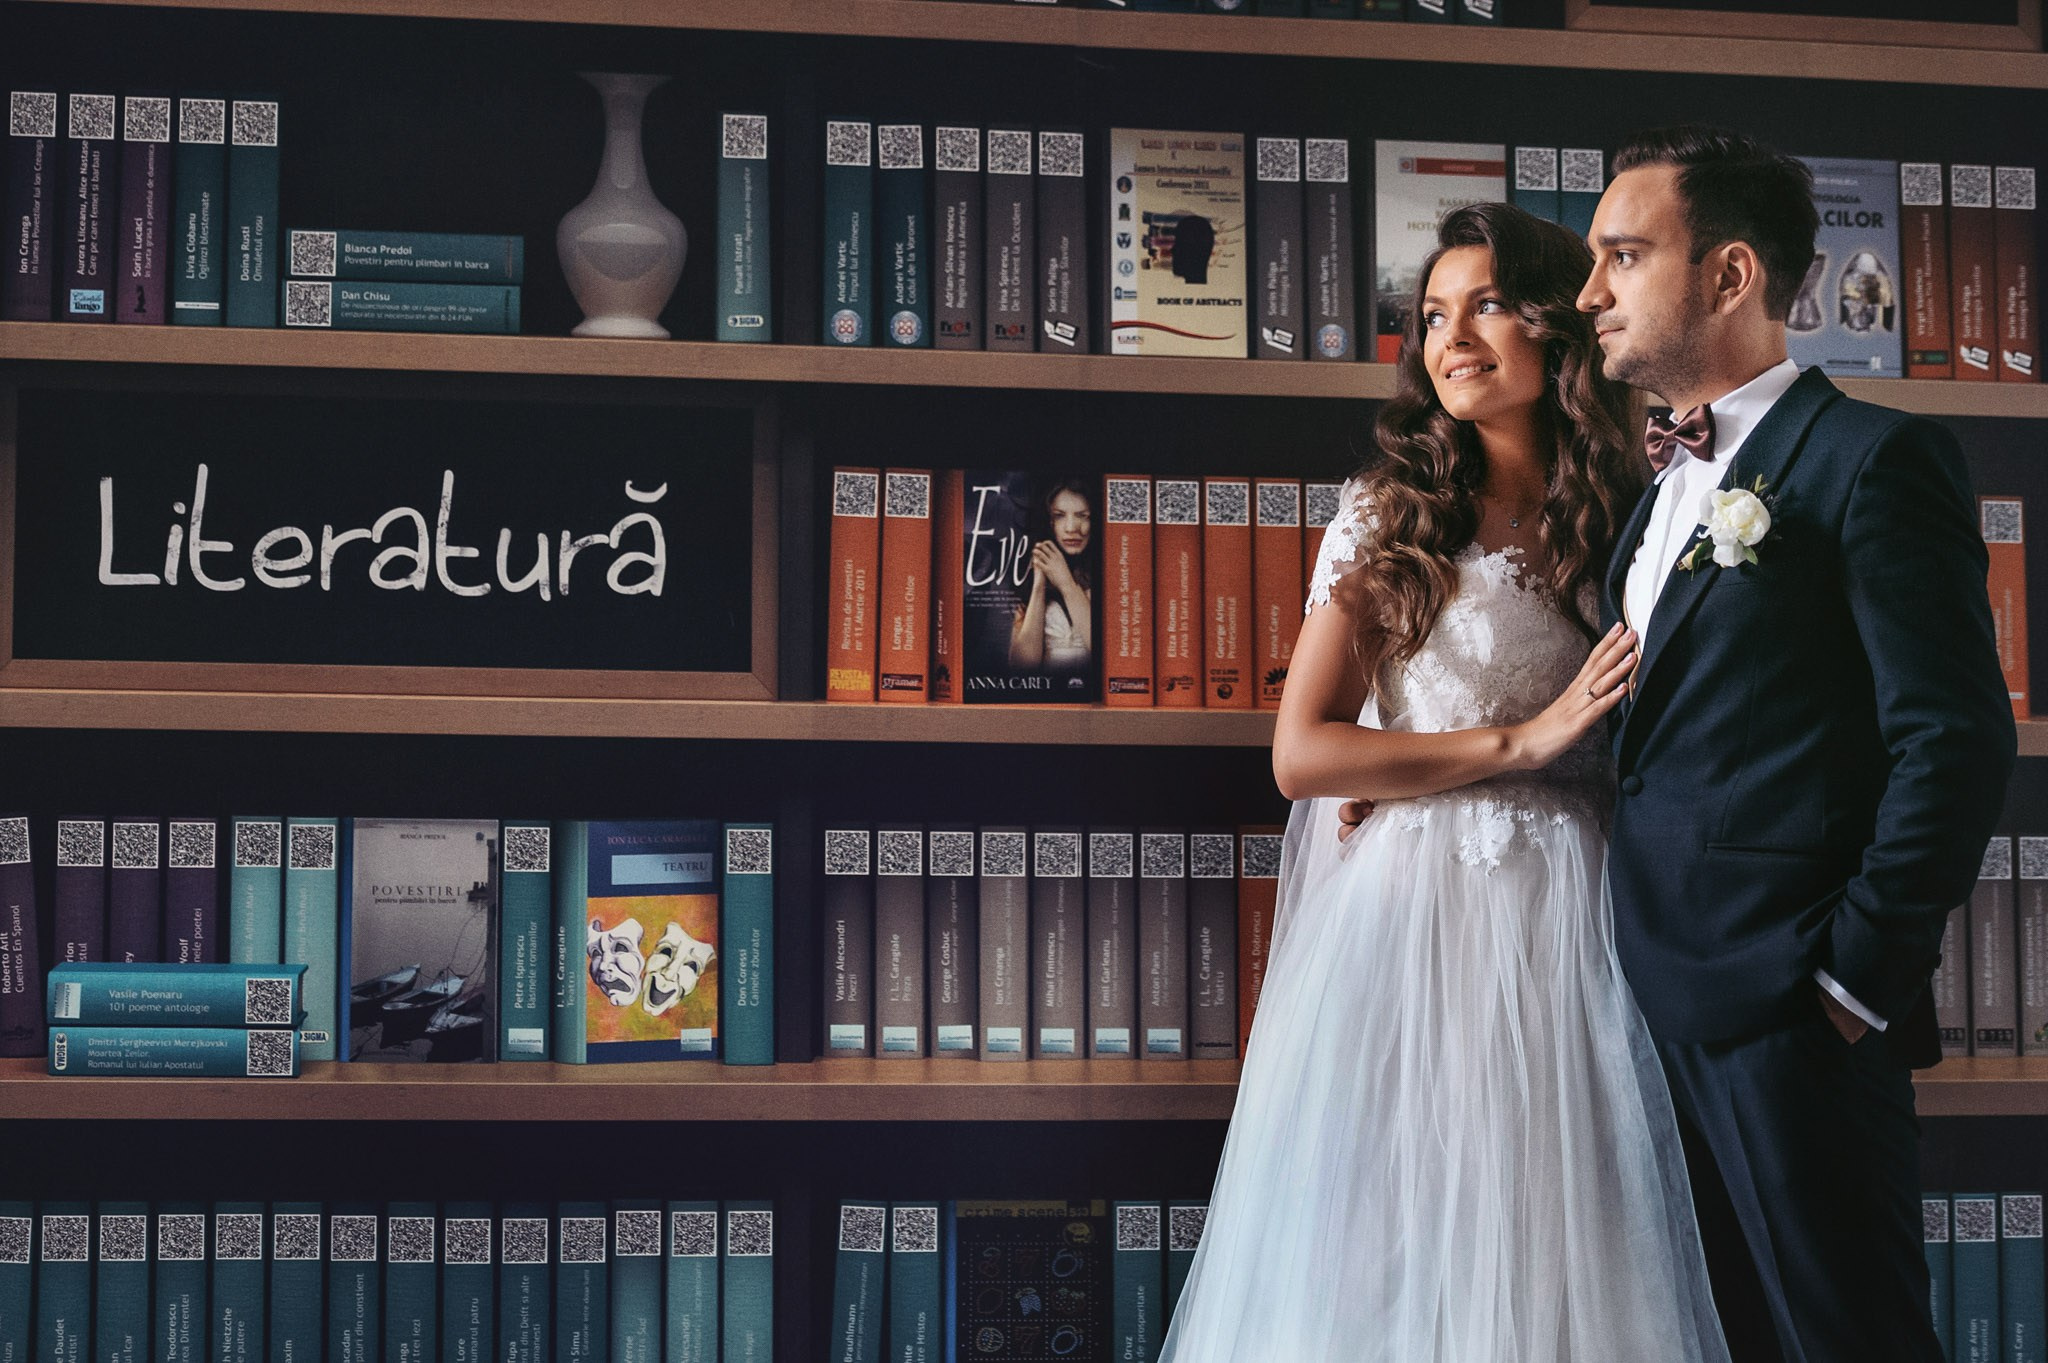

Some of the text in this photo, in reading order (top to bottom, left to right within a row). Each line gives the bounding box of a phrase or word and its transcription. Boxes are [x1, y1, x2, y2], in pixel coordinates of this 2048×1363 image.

[77, 140, 88, 276] Aurora Alice Nastase
[88, 193, 98, 276] Care care femei
[198, 191, 210, 280] Oglinzi blestemate
[945, 206, 955, 244] Ionescu
[958, 201, 967, 239] America
[1011, 202, 1021, 244] Occident
[19, 216, 32, 274] Ion Creanga
[132, 218, 143, 278] Sorin Lucaci
[186, 212, 196, 280] Livia Ciobanu
[240, 225, 250, 282] Doina Rusti
[253, 215, 263, 282] Omuletul rosu
[345, 242, 413, 255] Bianca Predoi
[345, 255, 490, 270] Povestiri pentru plimbari barca
[734, 233, 744, 295] Panait Istrati
[837, 241, 847, 304] Andrei Vartic
[849, 211, 860, 304] Timpul Eminescu
[906, 214, 917, 305] Codul Voronet
[341, 290, 391, 301] Dan Chisu
[894, 243, 905, 305] Andrei Vartic
[999, 246, 1009, 312] Irina Spirescu
[1048, 287, 1057, 313] Sorin
[1157, 297, 1243, 307] BOOK ABSTRACTS
[1320, 255, 1330, 317] Andrei Vartic
[98, 463, 667, 601] Literatură
[966, 485, 1034, 587] Eve
[841, 560, 854, 650] Revista povestiri
[855, 569, 865, 592] 2013
[1119, 535, 1129, 657] Bernardin Saint-Pierre
[1179, 551, 1189, 658] Arina tara numerelor
[892, 616, 903, 650] Longus
[904, 575, 915, 651] Daphnis Chloe
[1131, 590, 1142, 658] Paul Virginia
[1167, 599, 1177, 658] Eliza Roman
[1215, 597, 1226, 659] George Arion
[1227, 597, 1237, 659] Profesionistul
[1269, 604, 1279, 660] Anna Carey
[967, 676, 1053, 690] ANNA CAREY
[371, 885, 461, 896] POVESTIRI
[662, 861, 708, 873] TEATRU
[11, 905, 24, 994] Cuentos En Spanol
[193, 908, 204, 939] poetei
[1251, 911, 1261, 956] Dobrescu
[0, 932, 11, 994] Roberto Arlt
[515, 935, 526, 1009] Petre Ispirescu
[527, 921, 537, 1009] Basmele romanilor
[557, 926, 567, 981] Caragiale
[750, 927, 761, 1007] Cainele zburator
[835, 920, 845, 1002] Vasile Alecsandri
[890, 934, 900, 979] Caragiale
[941, 930, 952, 1004] George Cosbuc
[994, 947, 1006, 1006] Ion Creanga
[1046, 932, 1056, 1008] Mihai Eminescu
[1101, 939, 1111, 1008] Emil Garleanu
[1151, 951, 1161, 1007] Anton Pann
[1200, 926, 1212, 980] Caragiale
[109, 989, 183, 999] Vasile Poenaru
[109, 1002, 211, 1014] 101 poeme antologie
[567, 971, 576, 1007] Teatru
[848, 973, 858, 1002] Poezii
[1215, 971, 1225, 1008] Teatru
[88, 1037, 229, 1049] Dmitri Sergheevici Merejkovski
[88, 1050, 122, 1058] Moartea
[88, 1060, 205, 1070] Romanul Iulian Apostatul
[167, 1303, 177, 1361] Teodorescu
[180, 1293, 190, 1343] Diferentei
[223, 1307, 232, 1354] Nietzche
[355, 1273, 365, 1336] din constient
[471, 1297, 480, 1325] patru
[520, 1275, 530, 1346] din Delft alte
[916, 1311, 927, 1345] Hristos
[1136, 1284, 1147, 1359] de prosperitate
[54, 1318, 65, 1355] Daudet
[123, 1335, 133, 1353] Icar
[236, 1320, 246, 1354] putere
[412, 1319, 422, 1357] trei iezi
[457, 1338, 466, 1362] Lore
[570, 1331, 581, 1357] Simu
[844, 1303, 857, 1363] Brauhlmann
[1123, 1336, 1133, 1361] Oruz
[2014, 1322, 2025, 1350] Carey
